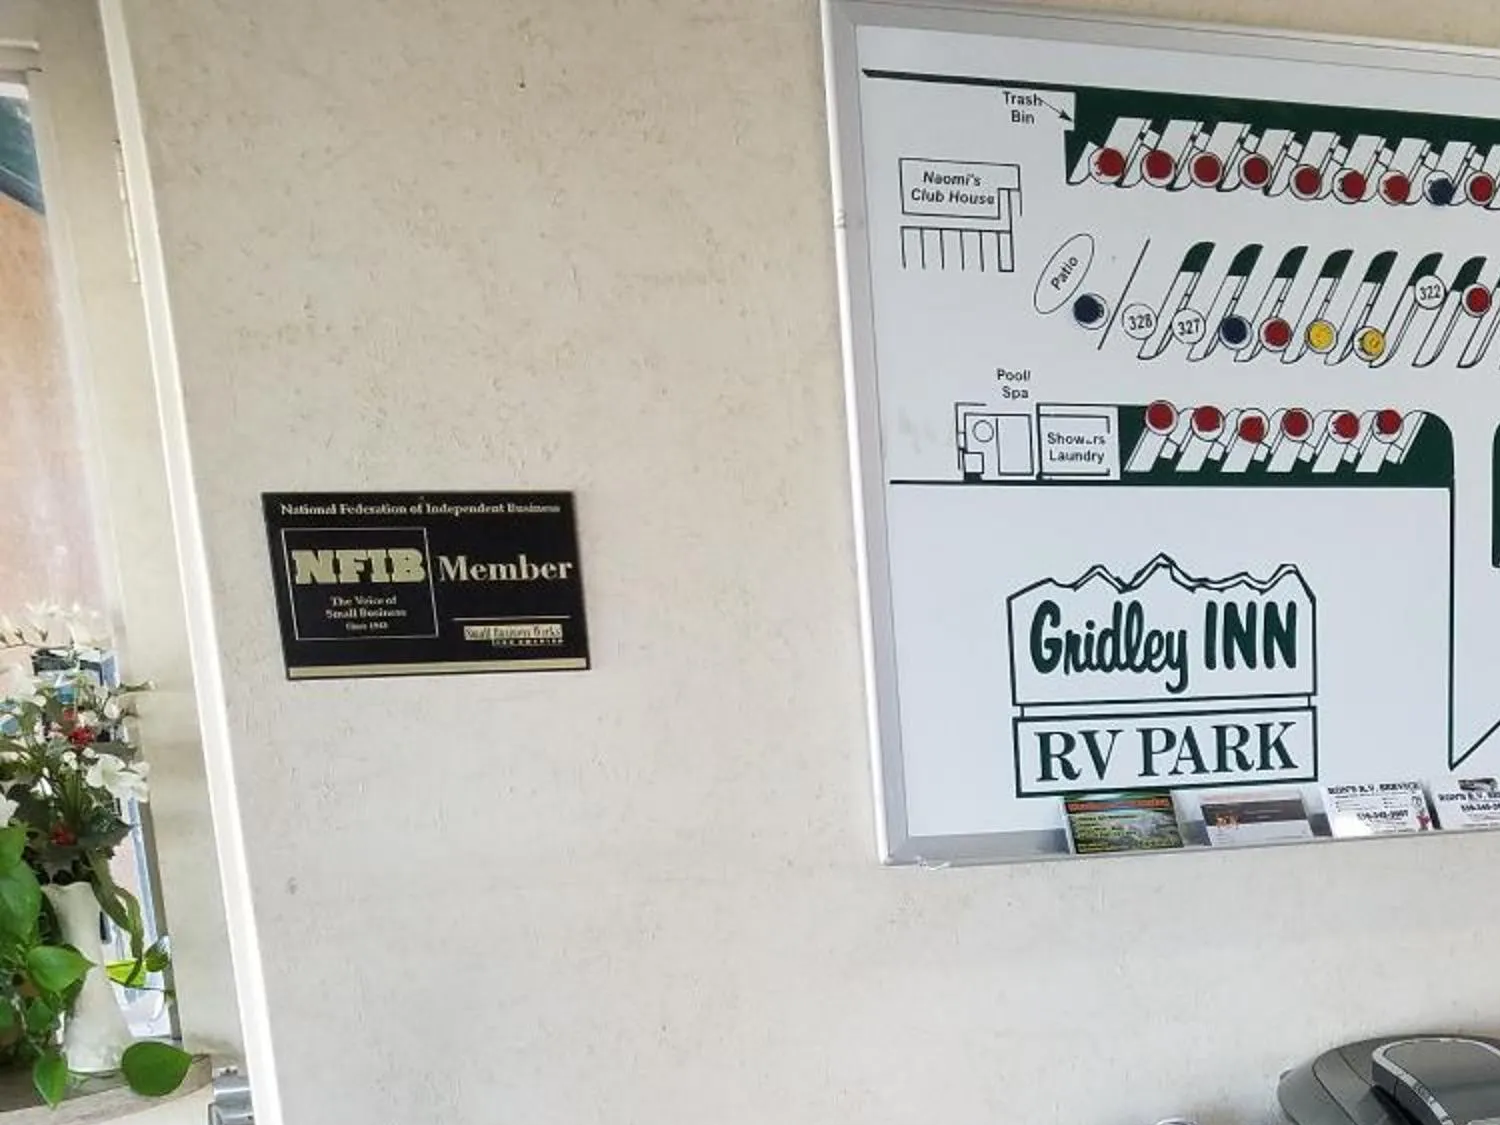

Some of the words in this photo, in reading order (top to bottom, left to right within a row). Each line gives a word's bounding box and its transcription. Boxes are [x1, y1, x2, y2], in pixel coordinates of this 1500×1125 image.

[1002, 91, 1043, 106] Trash
[1011, 109, 1035, 124] Bin
[923, 171, 981, 187] Naomi's
[911, 187, 945, 203] Club
[949, 190, 995, 205] House
[1050, 256, 1079, 291] Patio
[1419, 284, 1441, 301] 322
[1177, 318, 1200, 336] 327
[1002, 385, 1029, 400] Spa
[1047, 431, 1107, 445] Showrs
[1049, 449, 1105, 465] Laundry
[281, 503, 337, 516] National
[340, 503, 407, 515] Federation
[409, 503, 422, 515] of
[425, 503, 505, 517] Independent
[291, 547, 427, 585] NFIB
[437, 554, 574, 582] Member
[1030, 599, 1189, 694] Gridley
[1205, 600, 1297, 671] INN
[1034, 729, 1124, 782] RV
[1136, 721, 1299, 777] PARK
